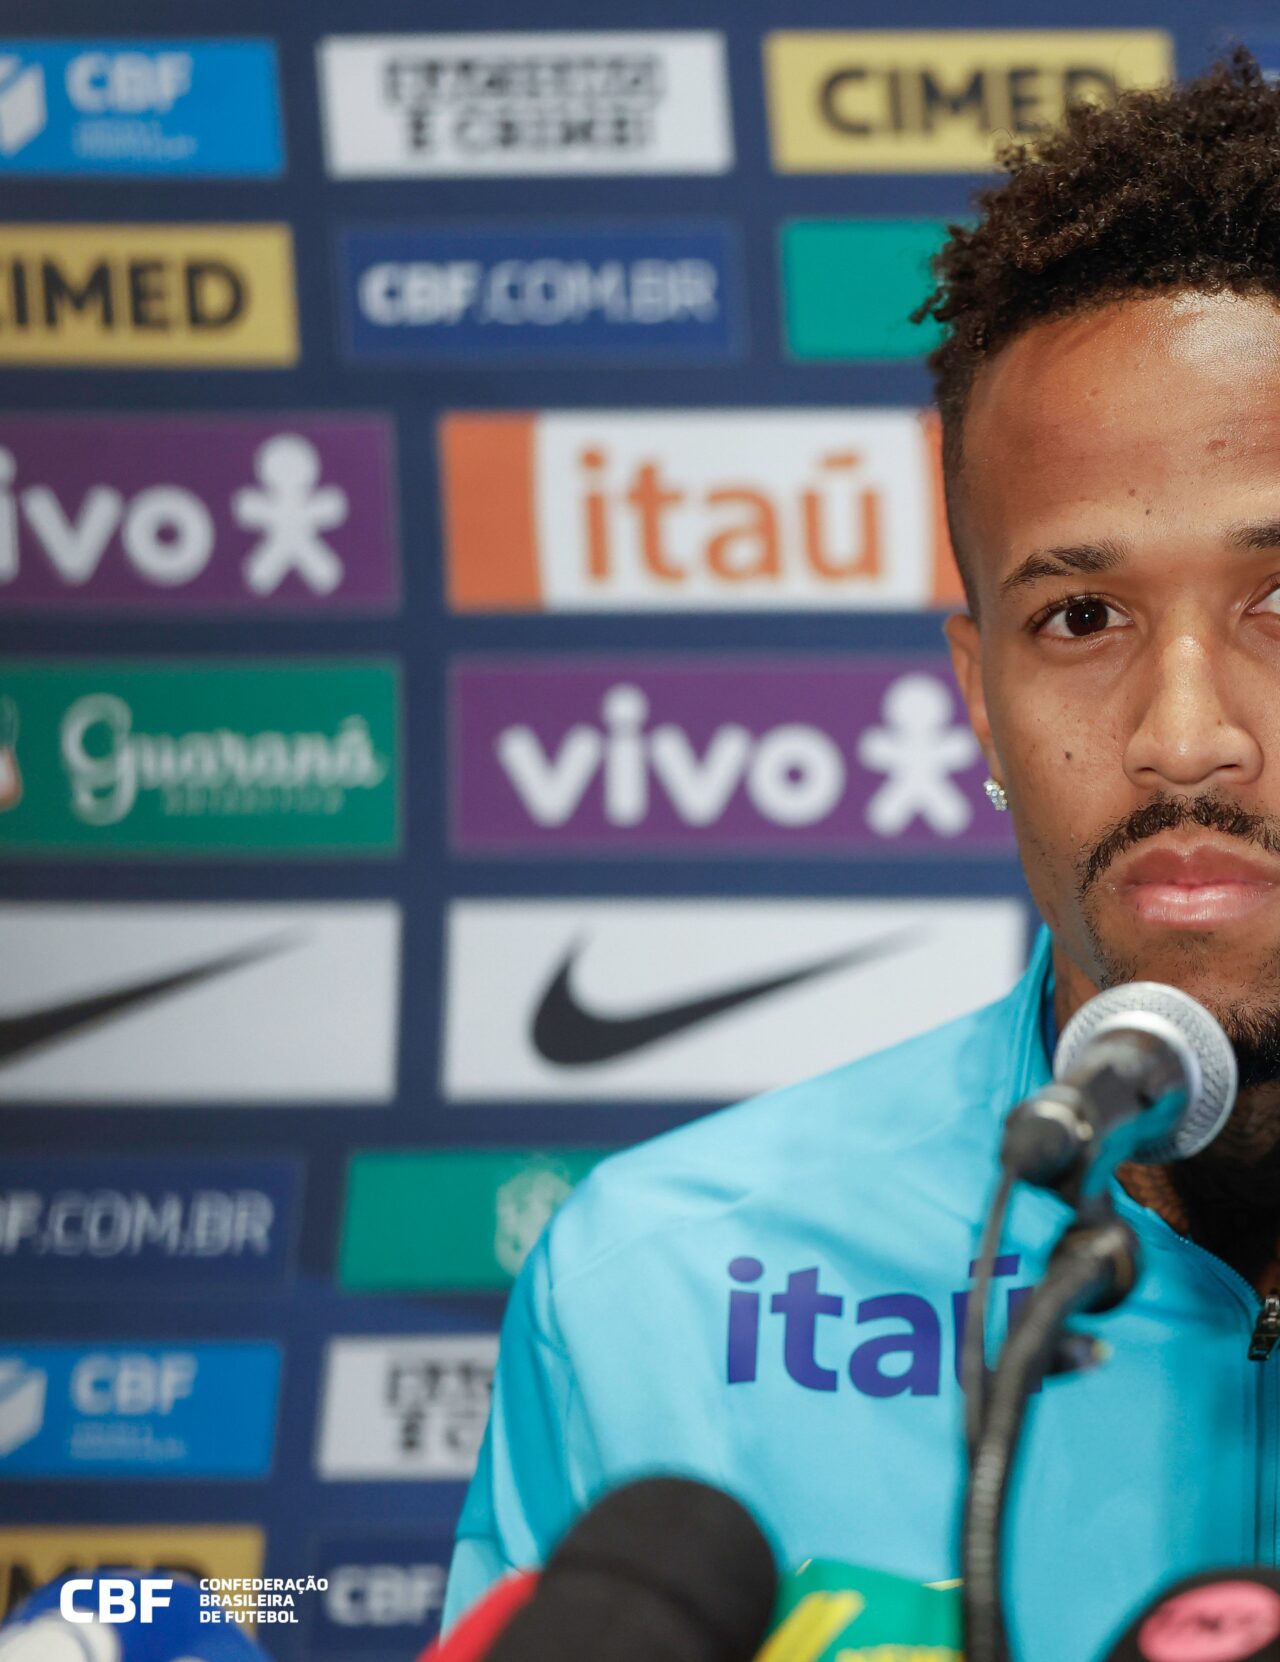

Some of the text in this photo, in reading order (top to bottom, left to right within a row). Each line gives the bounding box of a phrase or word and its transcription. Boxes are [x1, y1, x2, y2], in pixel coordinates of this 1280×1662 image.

[66, 53, 193, 113] CBF
[360, 260, 717, 324] CBF.COM.BR
[577, 447, 886, 586] itaú
[499, 686, 844, 826] vivo
[71, 1354, 197, 1415] CBF
